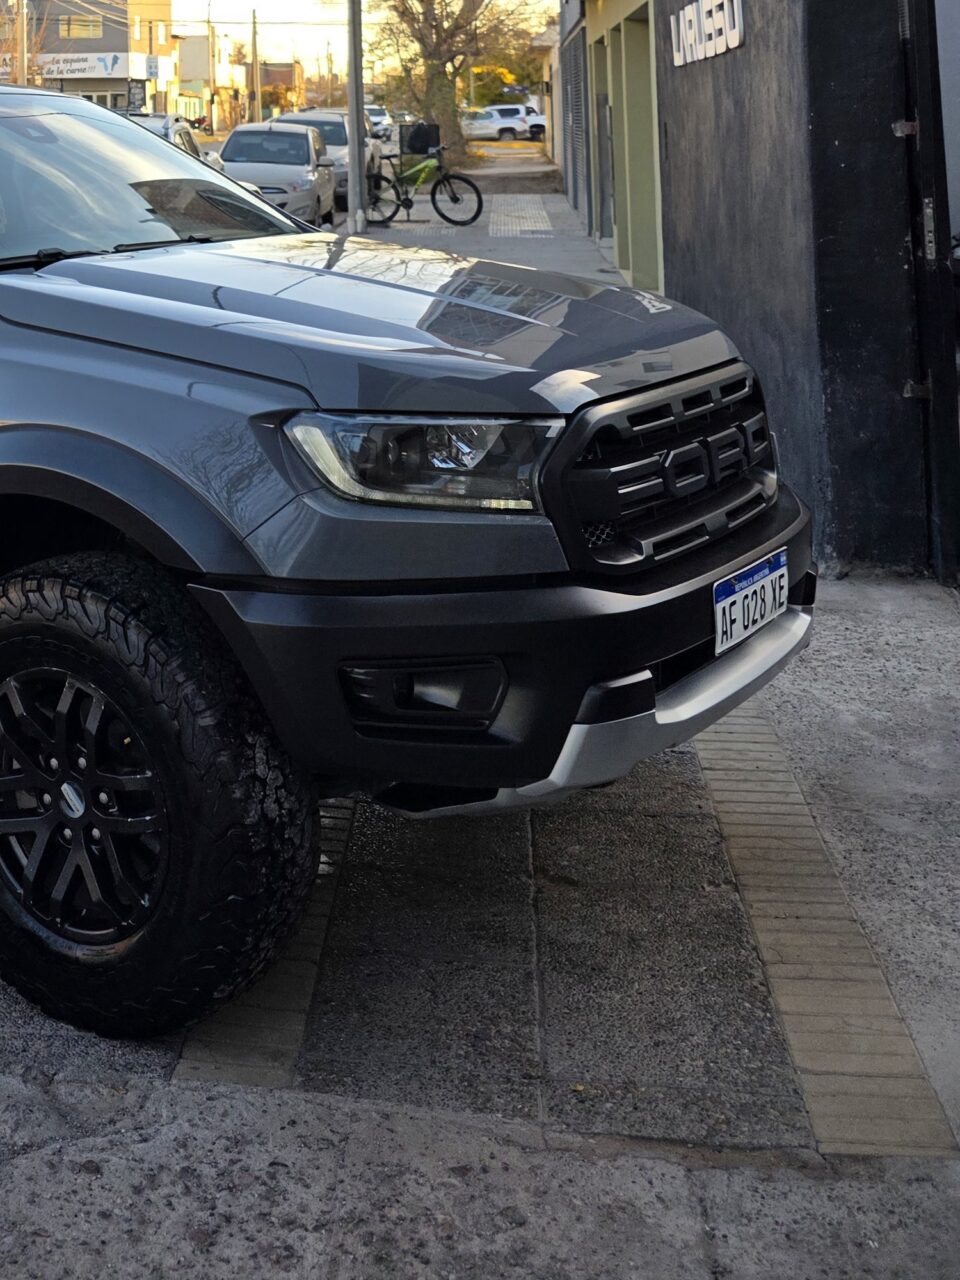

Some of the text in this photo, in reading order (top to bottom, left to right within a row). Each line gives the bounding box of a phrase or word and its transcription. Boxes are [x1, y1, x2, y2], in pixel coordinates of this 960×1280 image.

[721, 573, 785, 645] AF 028 XE
